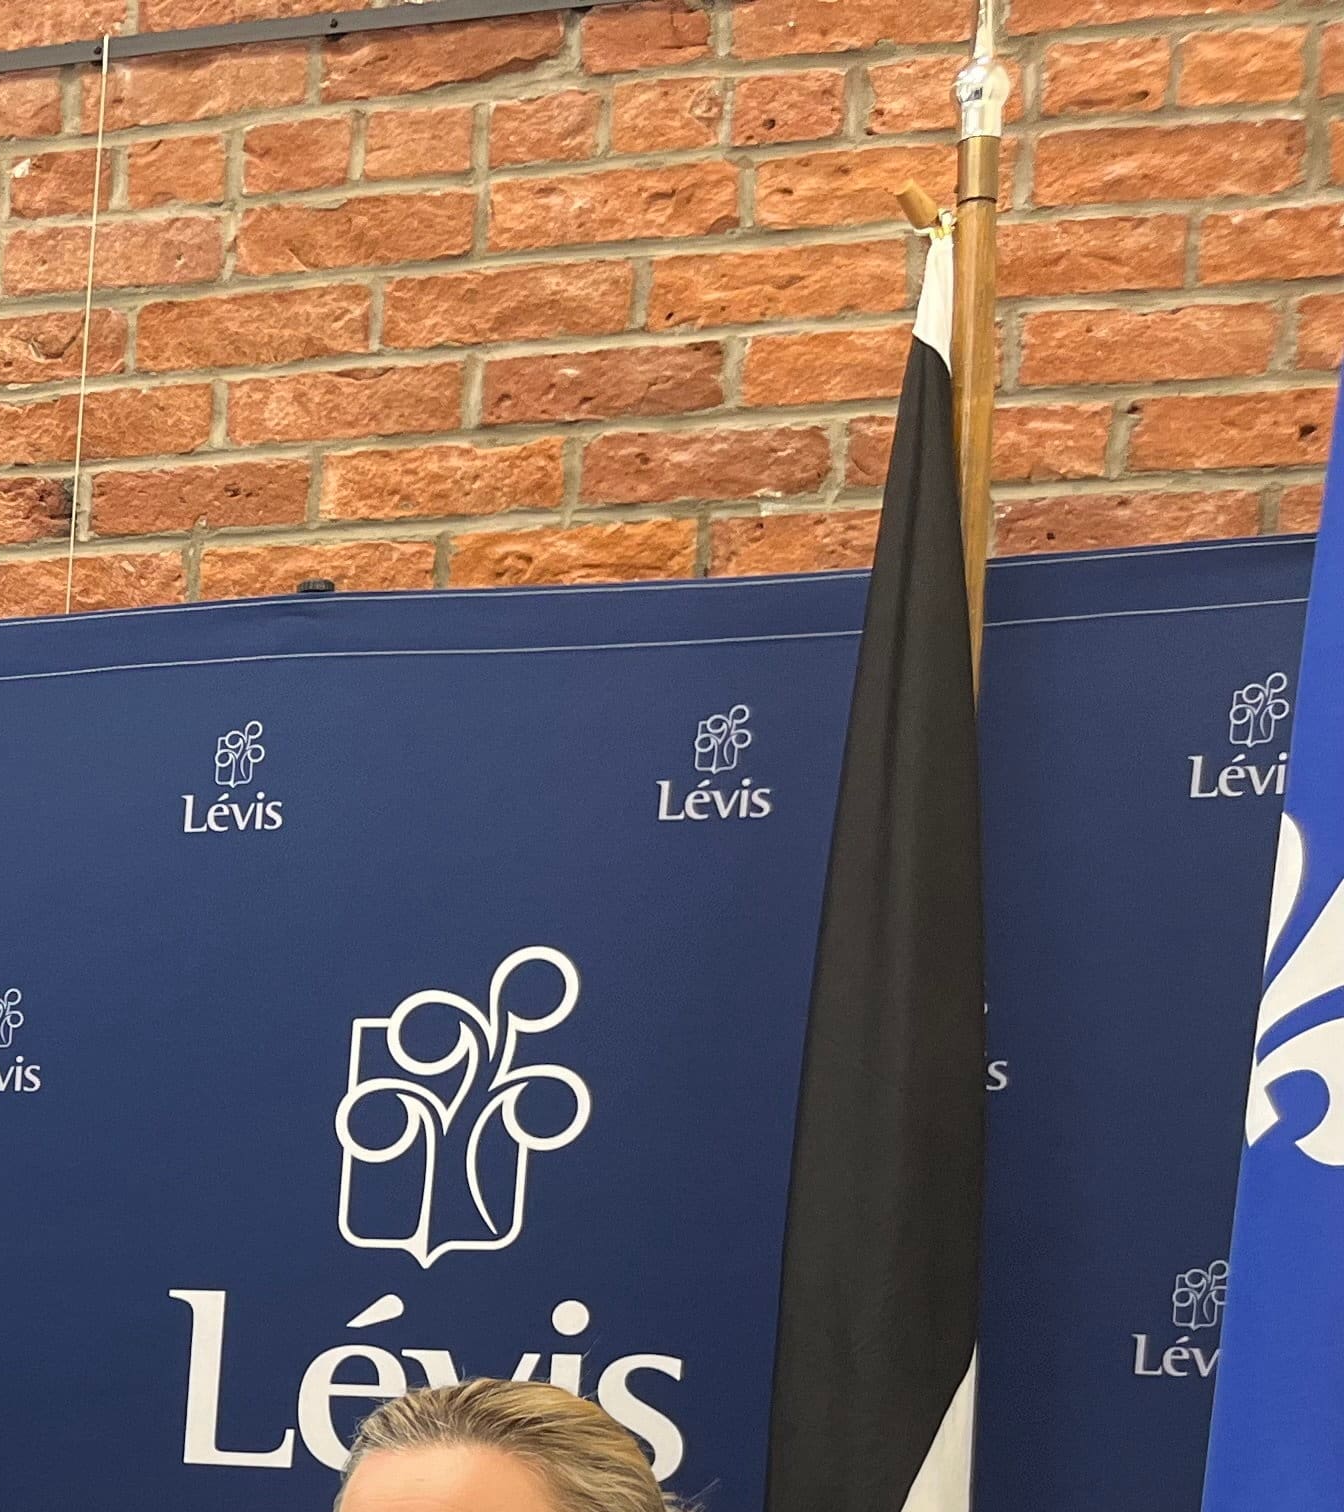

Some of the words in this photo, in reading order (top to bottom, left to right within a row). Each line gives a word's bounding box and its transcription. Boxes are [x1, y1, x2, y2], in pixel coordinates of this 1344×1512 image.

[1187, 752, 1289, 798] Lévi
[182, 792, 283, 834] Lévis
[655, 775, 772, 822] Lévis
[1131, 1333, 1222, 1378] Lév
